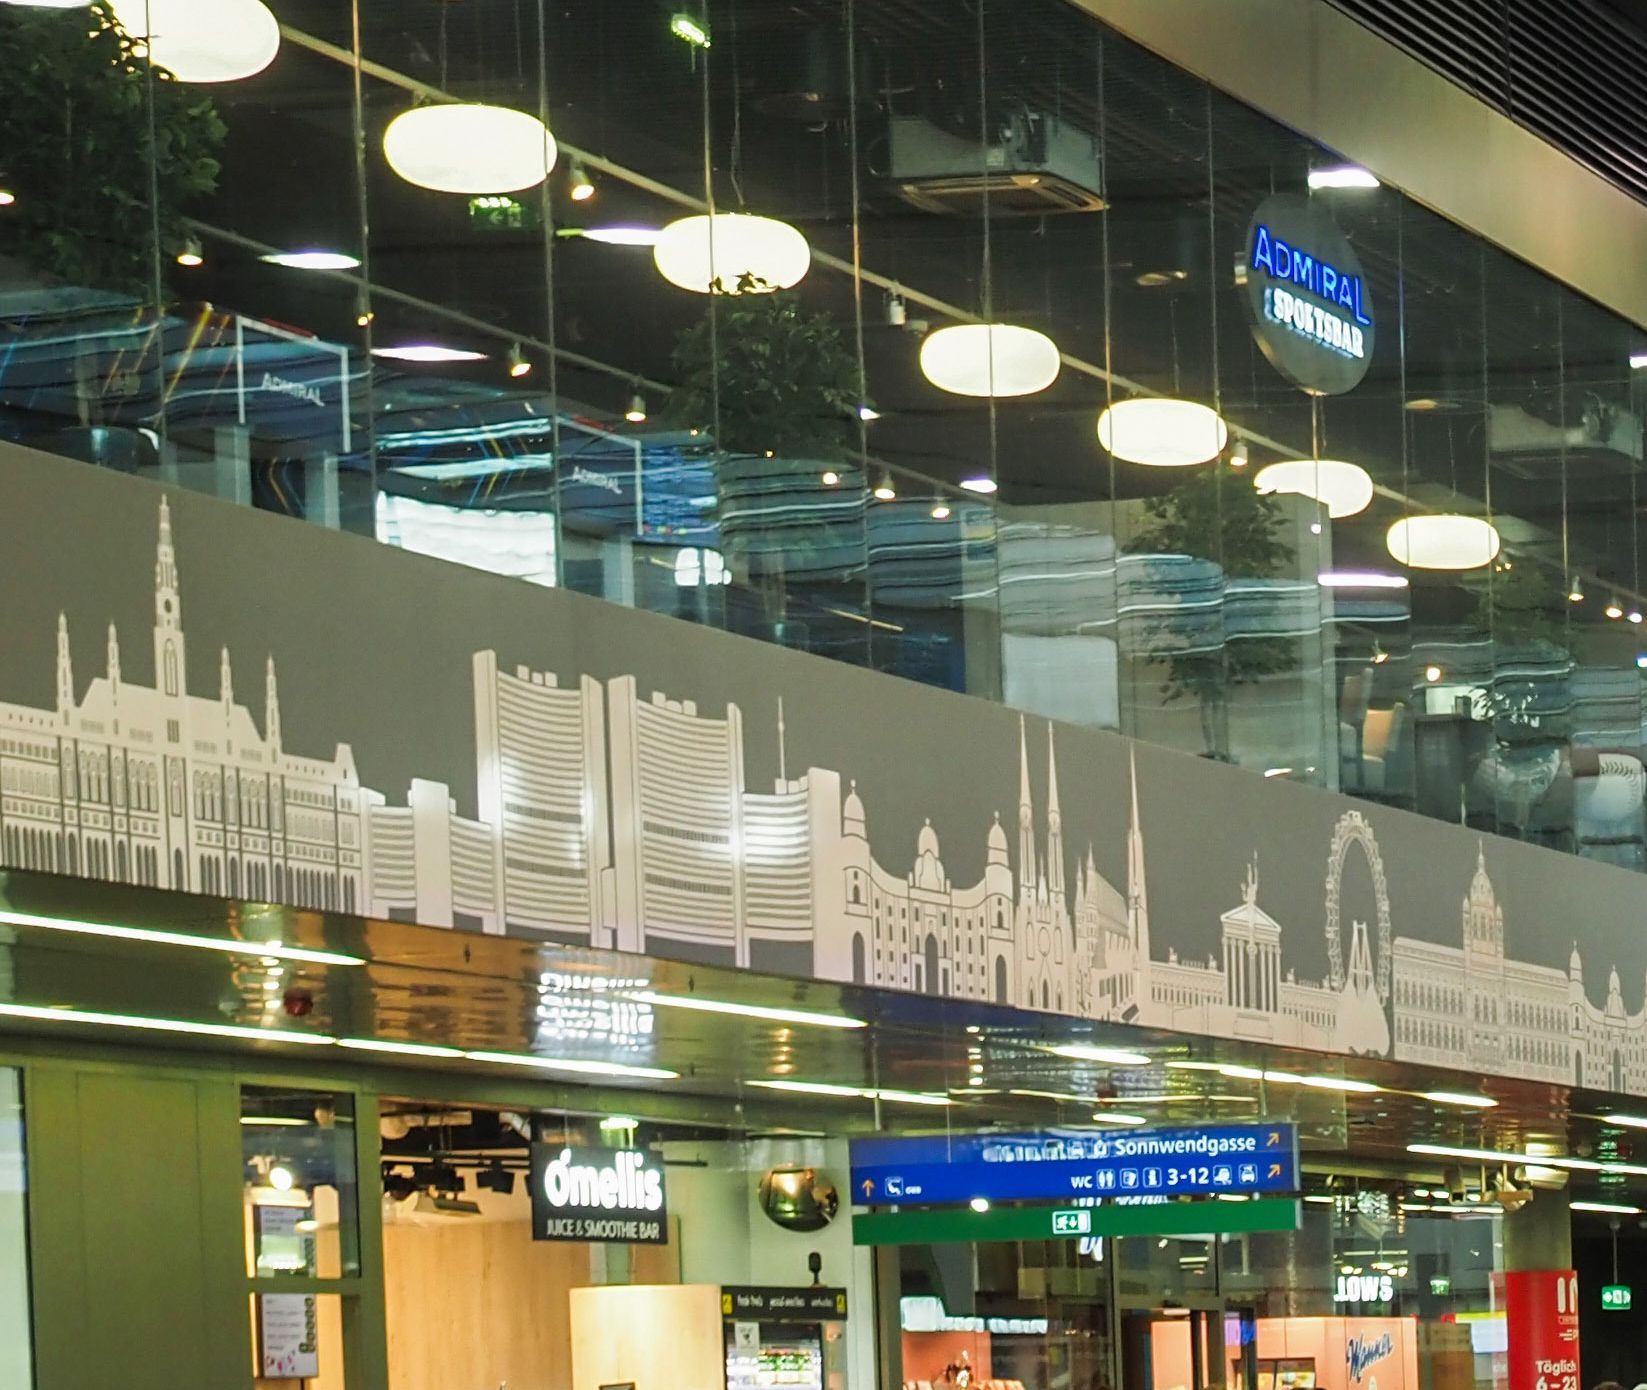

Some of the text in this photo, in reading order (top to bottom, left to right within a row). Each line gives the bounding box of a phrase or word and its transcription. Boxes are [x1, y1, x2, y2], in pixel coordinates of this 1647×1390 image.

[1253, 225, 1371, 326] ADMIRAL
[1271, 287, 1364, 358] SPORTSBAR
[261, 372, 325, 407] ADMIRAL
[572, 466, 623, 494] ADMIRAL
[1115, 1135, 1257, 1159] Sonnwendgasse
[1167, 1167, 1210, 1186] 3-12
[547, 1218, 660, 1240] JUICE & SMOOTHIE BAR
[1536, 1360, 1577, 1377] Täglich
